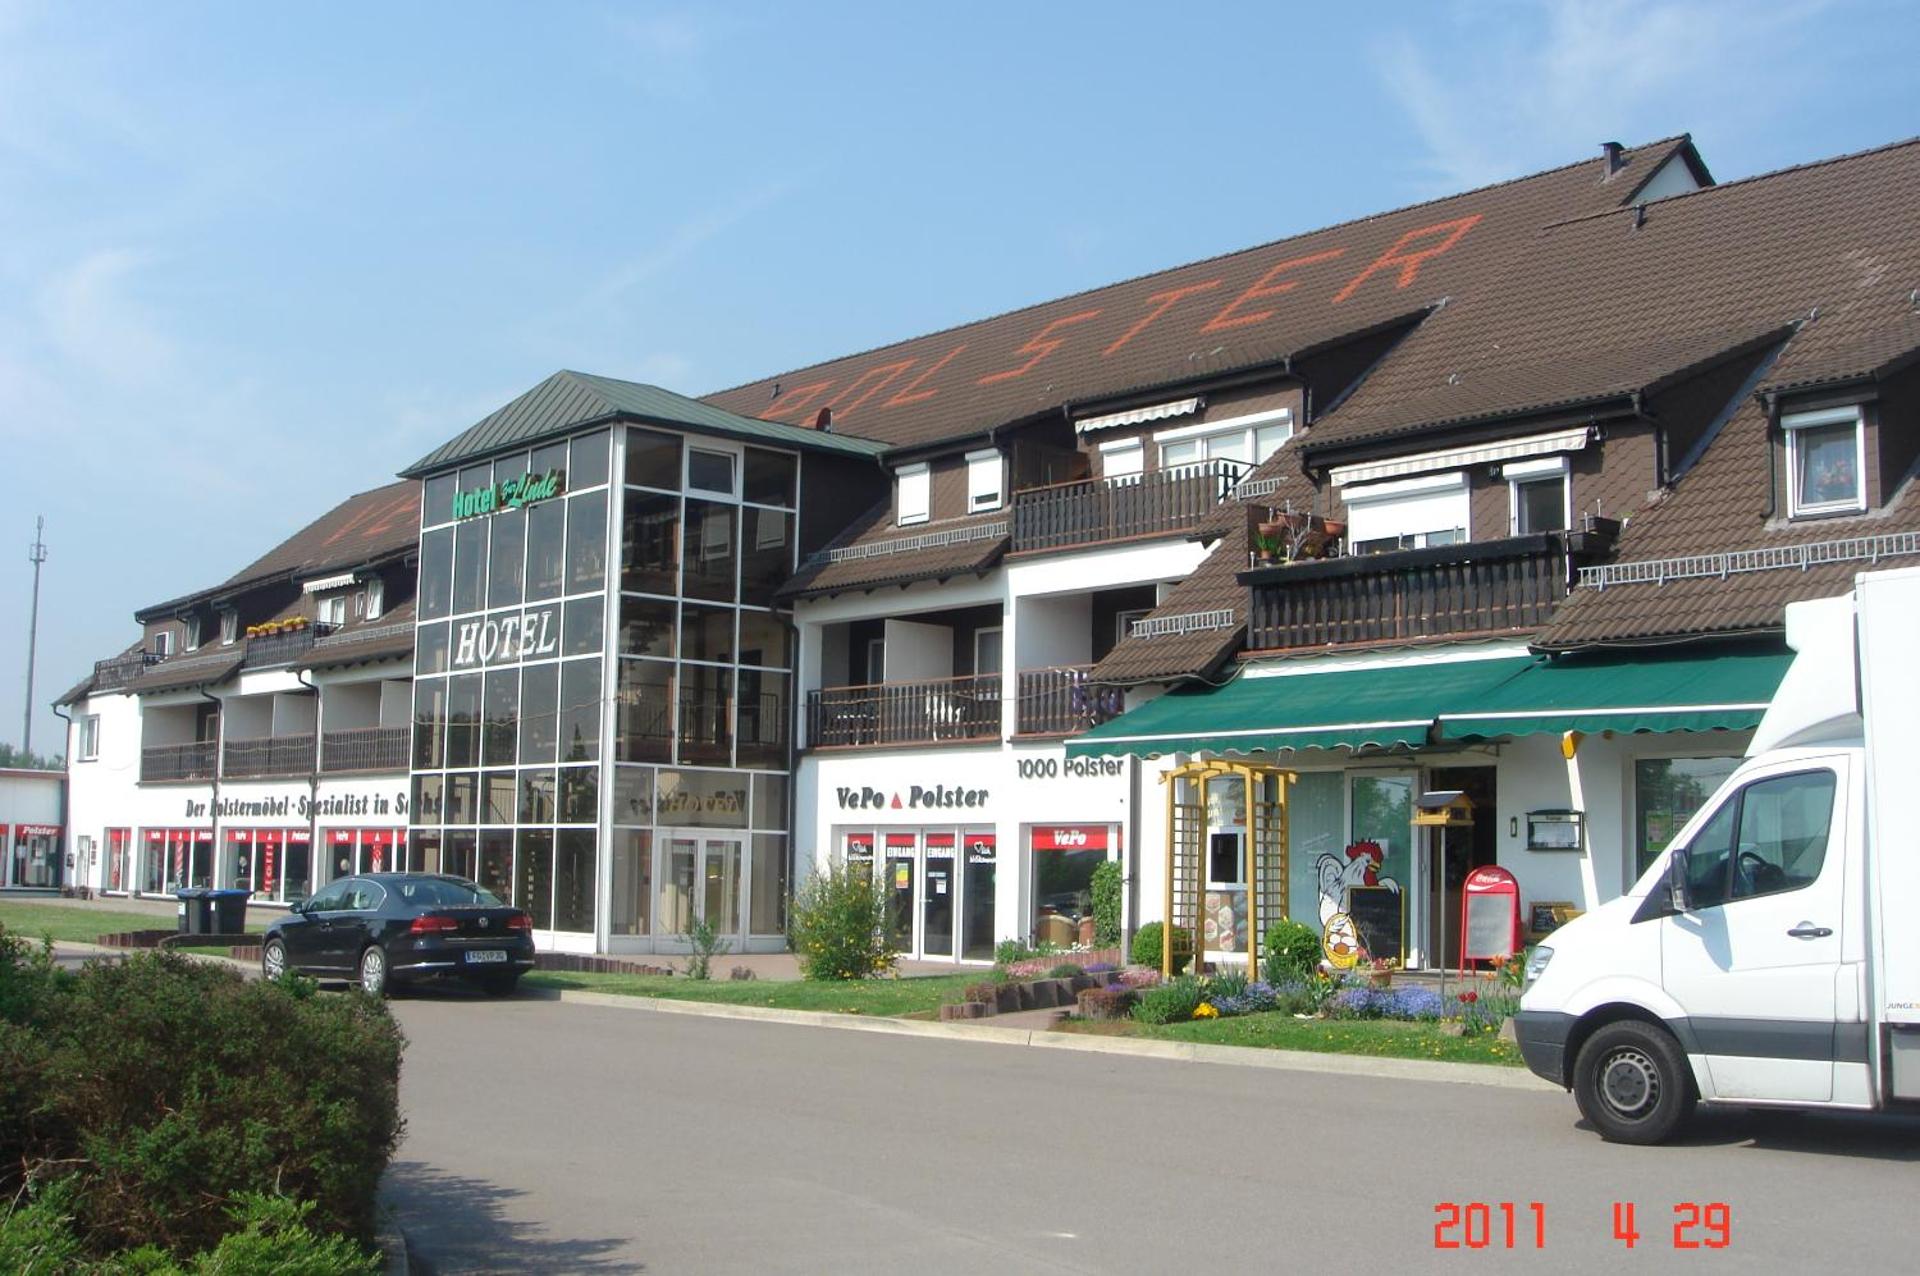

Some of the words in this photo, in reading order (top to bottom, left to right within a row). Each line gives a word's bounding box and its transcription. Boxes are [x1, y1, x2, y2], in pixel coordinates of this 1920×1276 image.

[453, 483, 496, 520] Hotel
[508, 467, 557, 507] Linde
[455, 611, 557, 665] HOTEL
[1017, 758, 1057, 778] 1000
[1063, 757, 1124, 777] Polster
[186, 799, 206, 818] Der
[373, 793, 389, 814] in
[836, 786, 885, 809] VePo
[908, 784, 989, 808] Polster
[1054, 830, 1087, 845] VePo
